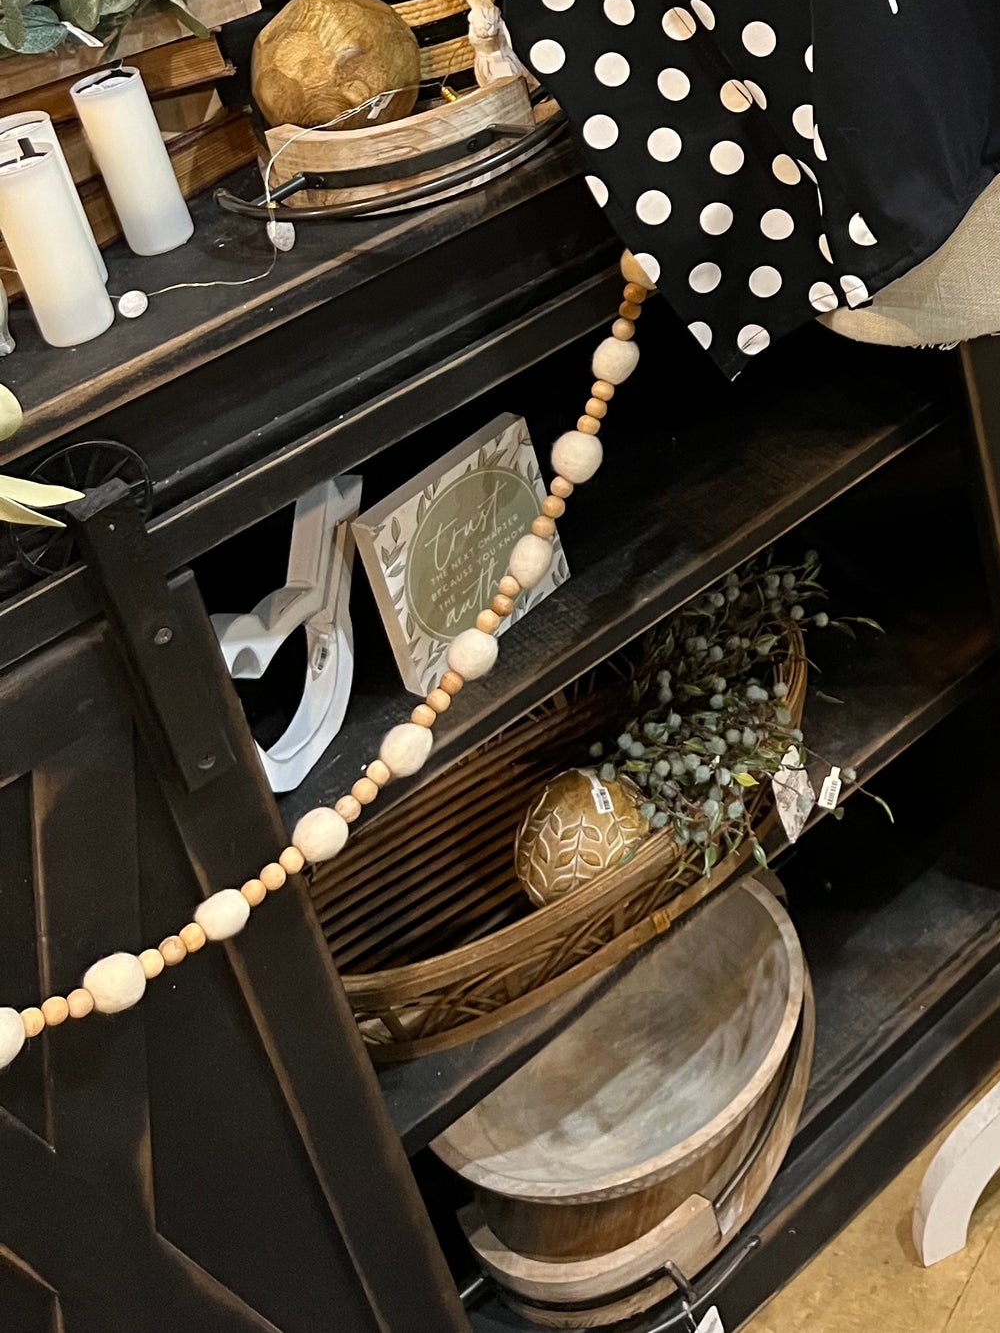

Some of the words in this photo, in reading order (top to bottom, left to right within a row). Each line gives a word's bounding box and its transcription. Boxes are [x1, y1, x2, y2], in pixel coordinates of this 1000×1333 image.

[424, 480, 507, 571] trust
[430, 570, 447, 586] THE
[451, 548, 475, 570] NEXT
[478, 513, 519, 549] CHAPTER
[431, 564, 473, 602] BECAUSE
[477, 547, 497, 565] YOU
[499, 525, 526, 549] KNOW
[439, 594, 456, 611] THE
